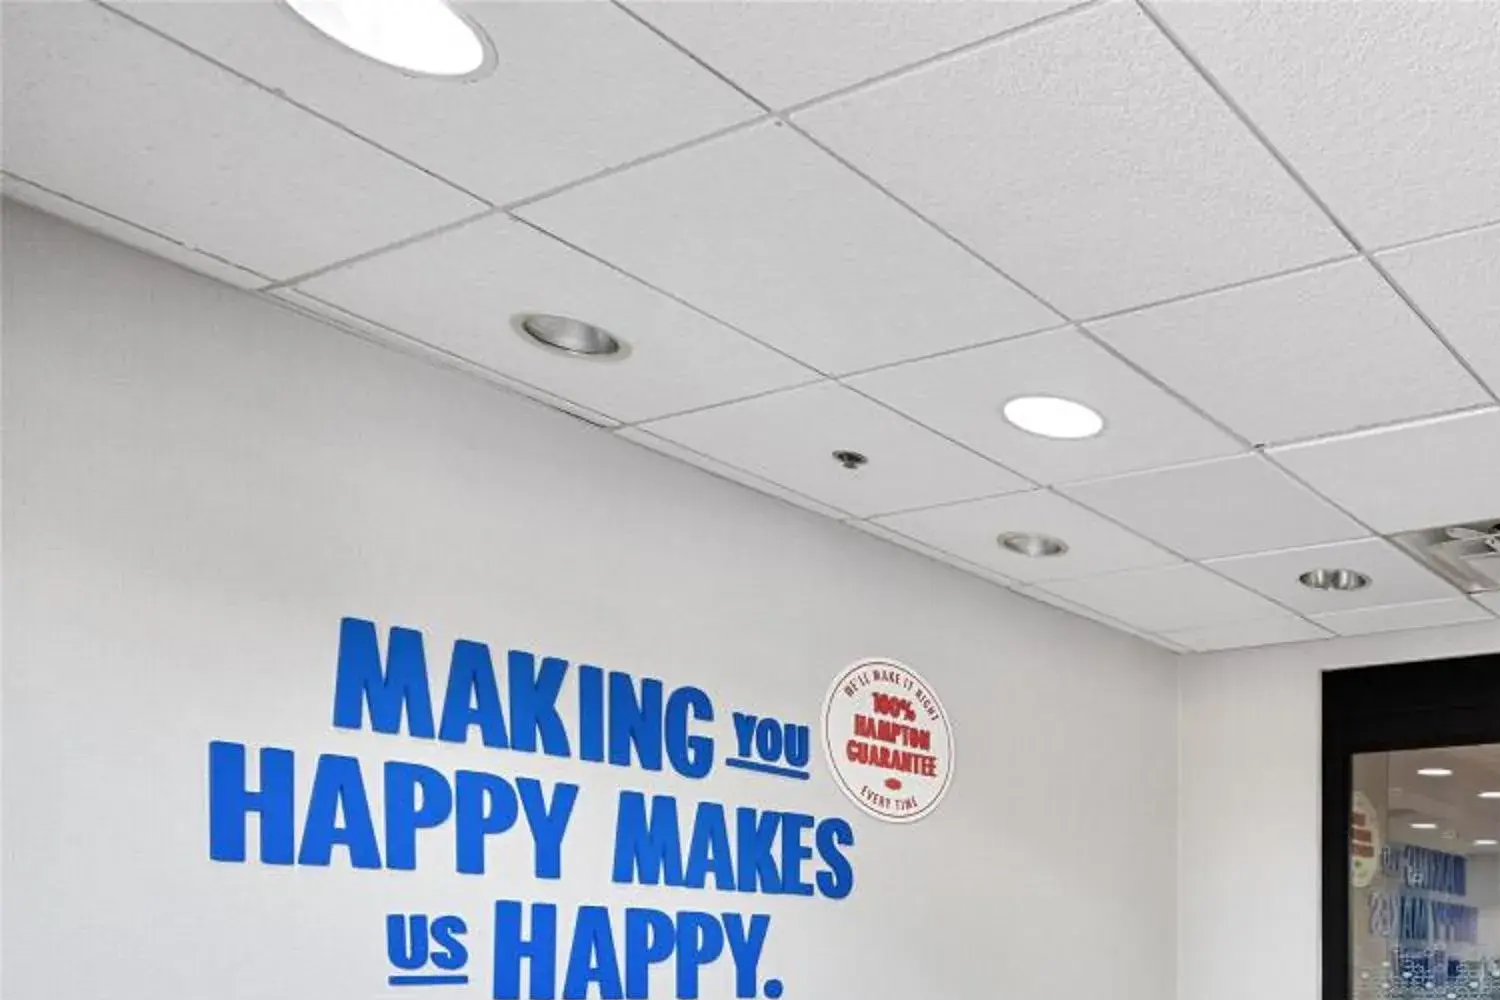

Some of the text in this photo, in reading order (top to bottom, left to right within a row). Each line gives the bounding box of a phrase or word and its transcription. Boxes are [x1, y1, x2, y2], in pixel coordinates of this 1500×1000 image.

[333, 616, 810, 779] MAKING YOU
[872, 692, 917, 722] 100%
[873, 669, 901, 685] MAKE
[903, 676, 914, 692] IT
[915, 688, 940, 721] RIGHT
[854, 713, 931, 752] HAMPTON
[846, 739, 938, 778] GUARANTEE
[208, 740, 855, 899] HAPPY MAKES
[859, 785, 919, 811] EVERY TIME
[385, 913, 469, 971] US
